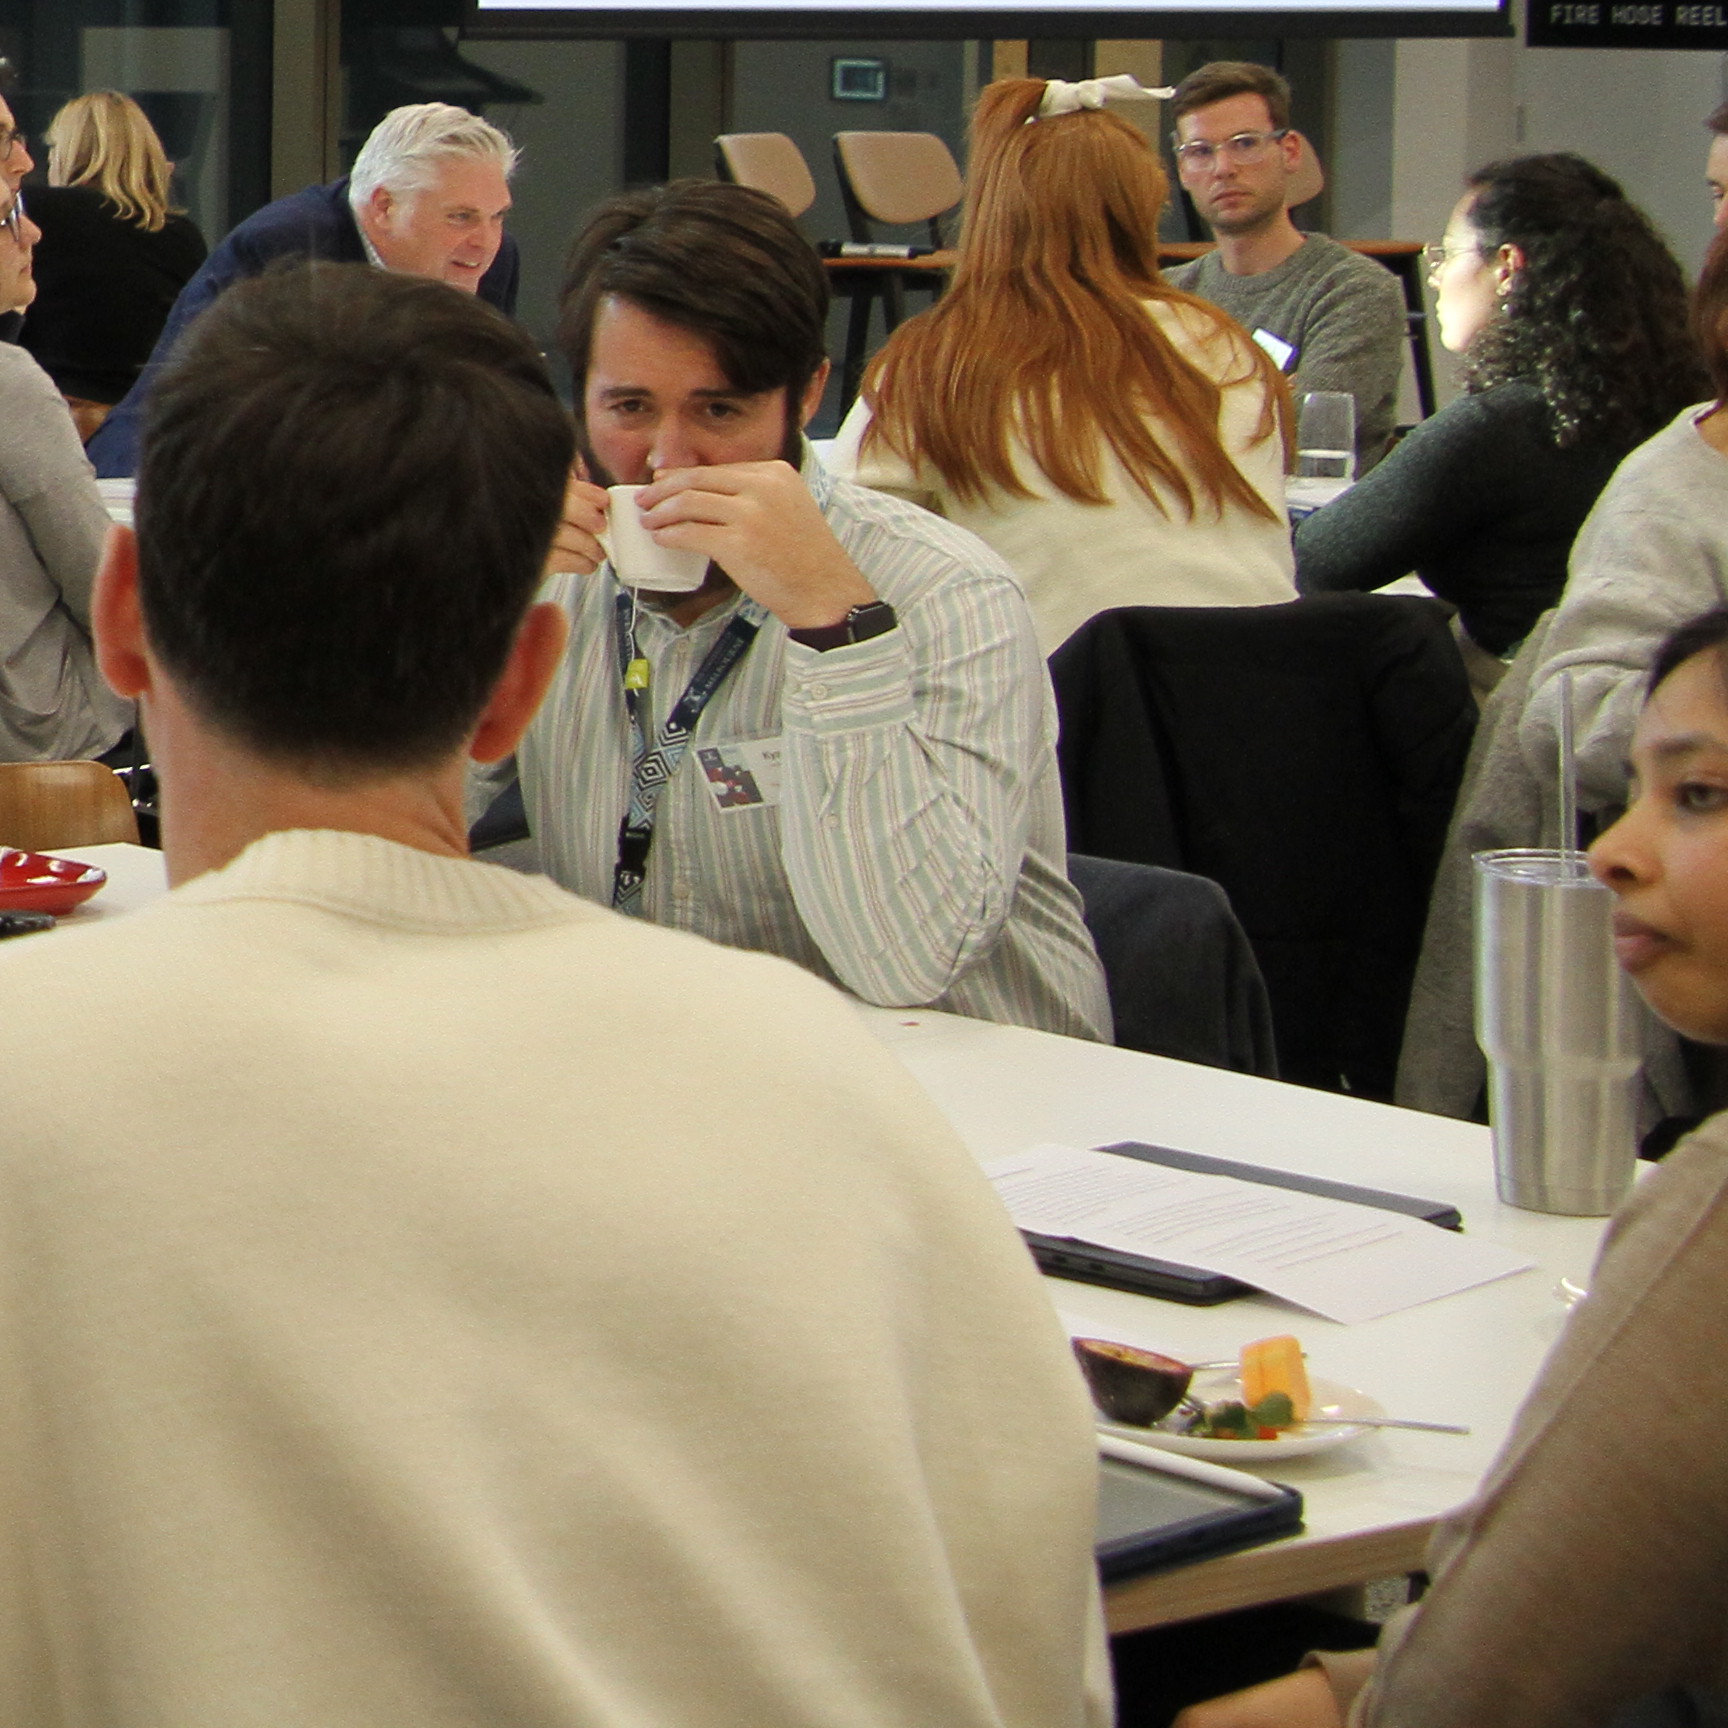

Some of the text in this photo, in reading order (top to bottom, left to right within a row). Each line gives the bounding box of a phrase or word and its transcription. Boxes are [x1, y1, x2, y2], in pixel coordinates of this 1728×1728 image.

[1550, 4, 1728, 26] FIRE HOSE REEL
